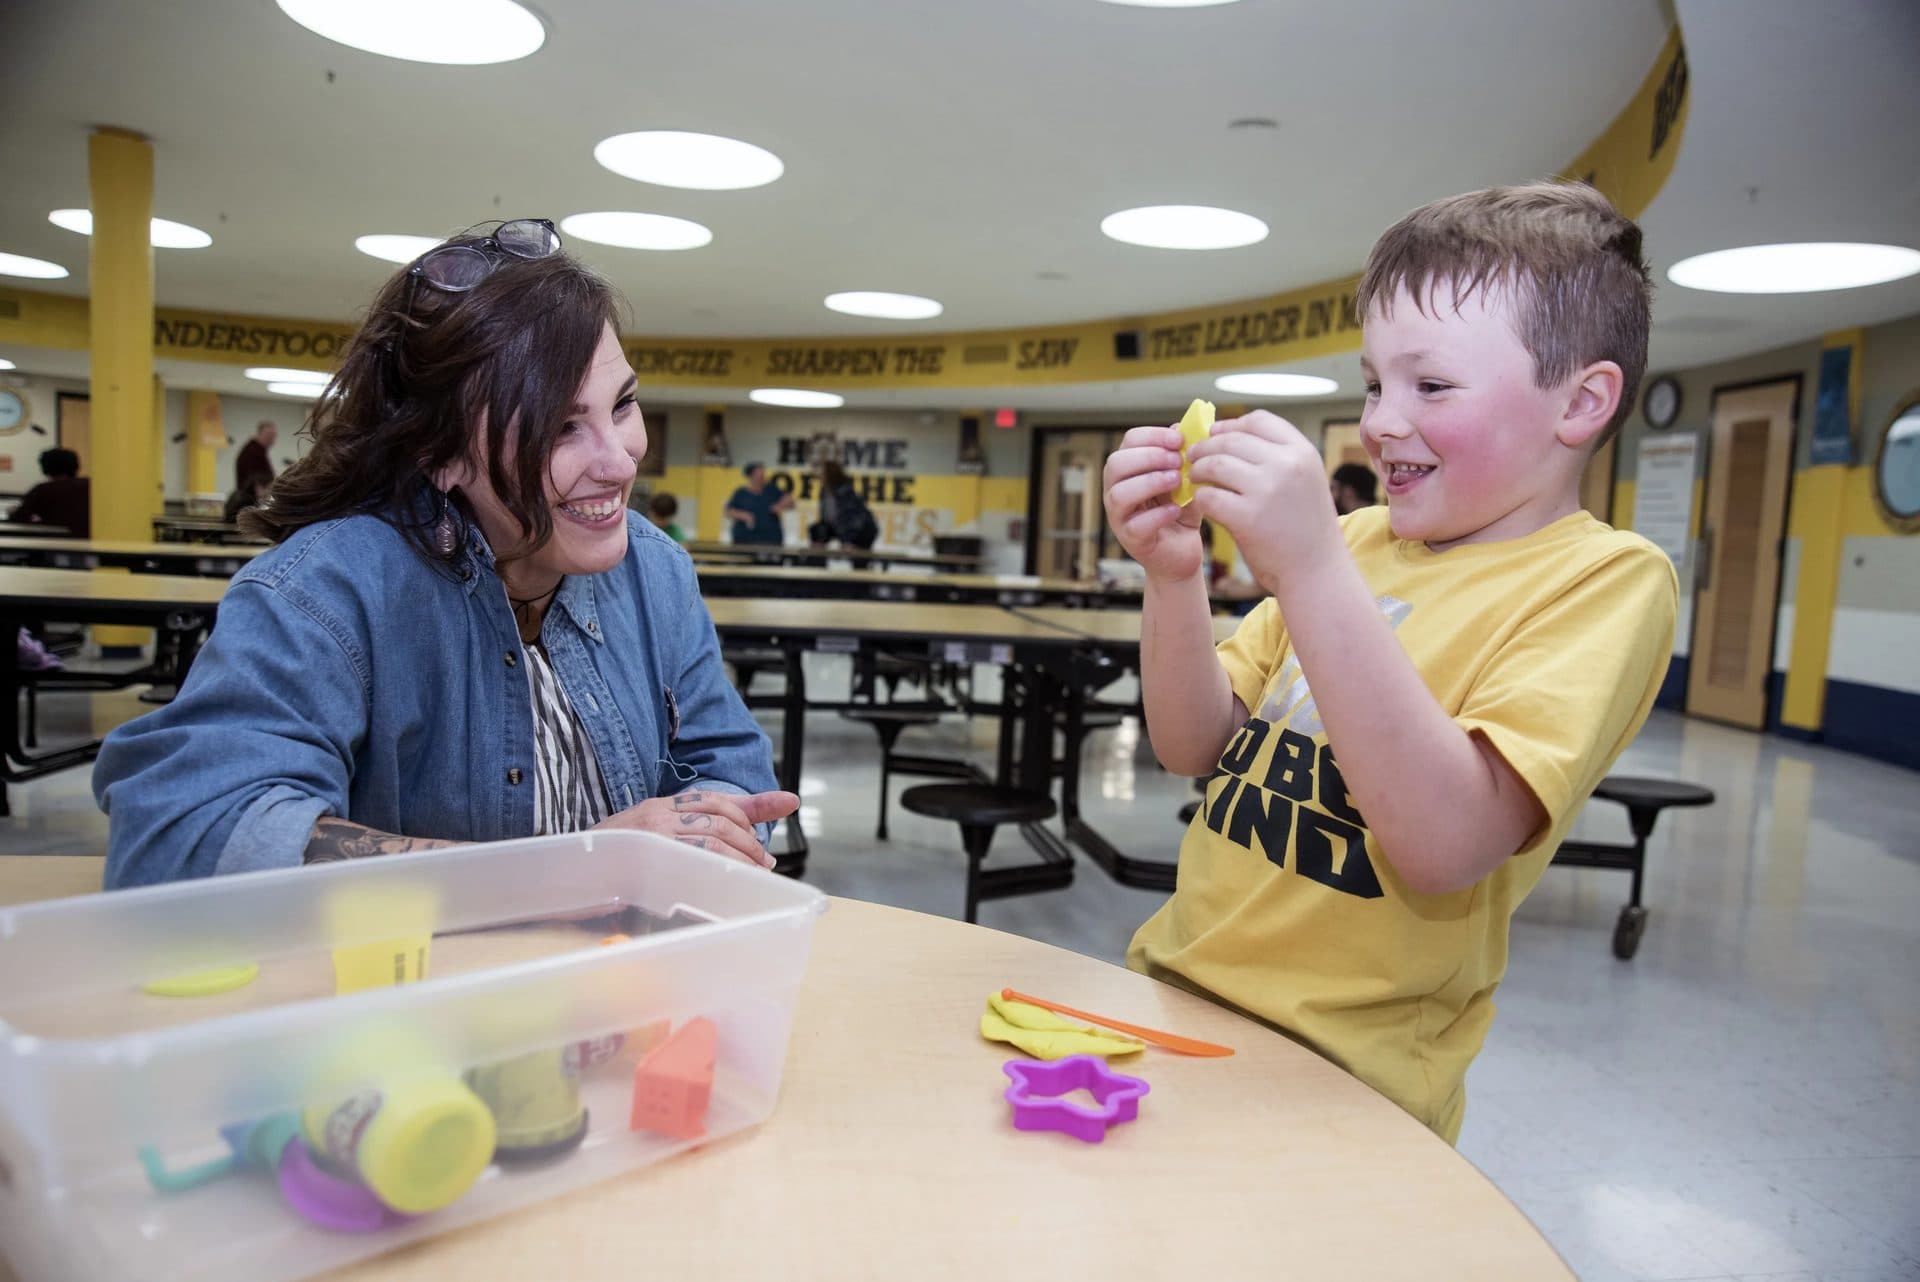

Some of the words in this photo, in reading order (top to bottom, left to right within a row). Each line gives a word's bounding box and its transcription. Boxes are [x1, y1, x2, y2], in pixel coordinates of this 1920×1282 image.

[154, 319, 350, 359] NDERSTOO
[1151, 322, 1202, 361] THE
[1204, 304, 1301, 355] LEADER
[1304, 296, 1337, 338] IN
[630, 347, 735, 376] ERGIZE
[766, 346, 885, 376] SHARPEN
[891, 345, 947, 375] THE
[1016, 337, 1080, 371] SAW
[853, 474, 916, 504] HE
[1203, 768, 1385, 899] IND
